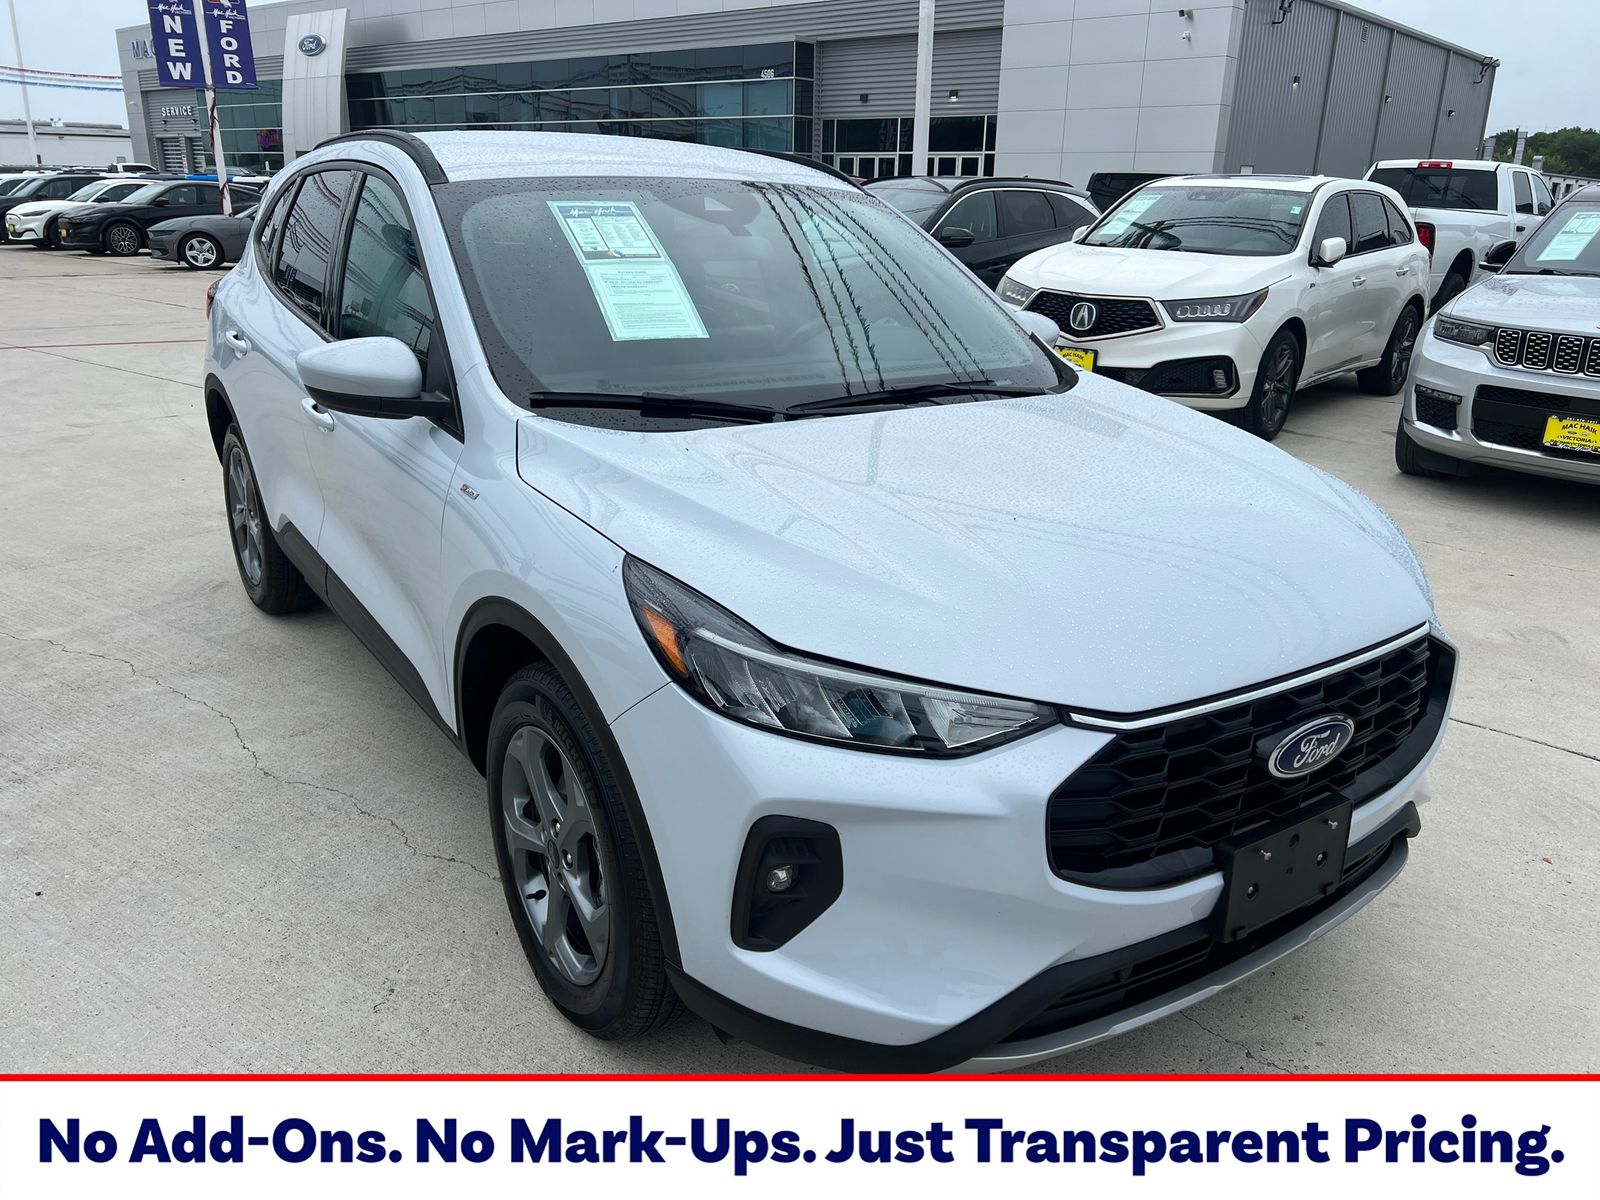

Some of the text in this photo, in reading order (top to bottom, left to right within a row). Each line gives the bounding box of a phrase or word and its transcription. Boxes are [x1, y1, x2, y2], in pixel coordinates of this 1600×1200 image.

[163, 15, 192, 81] NEW
[219, 19, 243, 84] FORD
[161, 105, 192, 117] SERVICE
[1562, 435, 1592, 443] VICTORIA
[1579, 423, 1598, 435] HAIK
[1293, 730, 1341, 768] Ford
